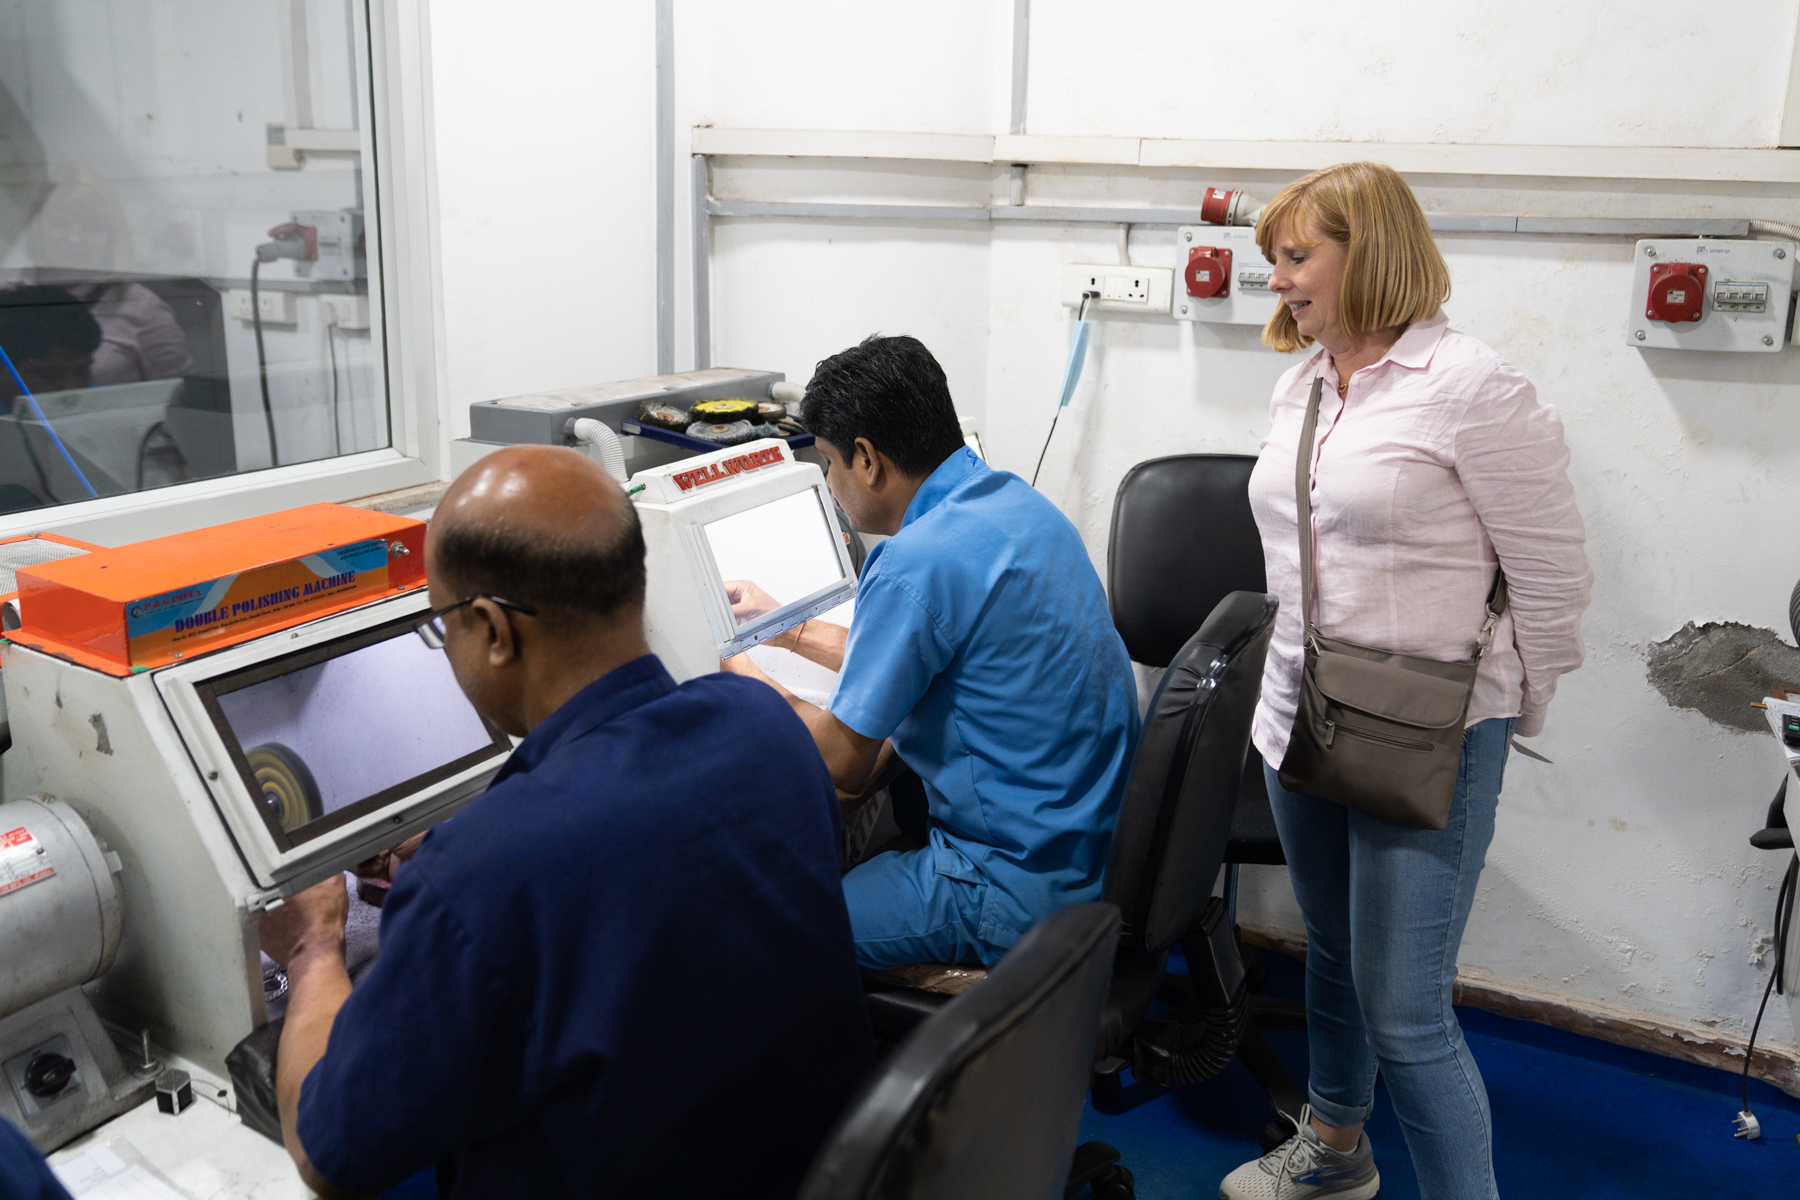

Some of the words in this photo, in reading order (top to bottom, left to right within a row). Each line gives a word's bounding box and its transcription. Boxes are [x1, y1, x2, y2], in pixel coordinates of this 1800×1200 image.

[143, 603, 151, 611] P
[171, 589, 202, 604] IMPEX
[174, 606, 229, 633] DOUBLE
[232, 586, 300, 617] POLISHING
[303, 570, 356, 597] MACHINE
